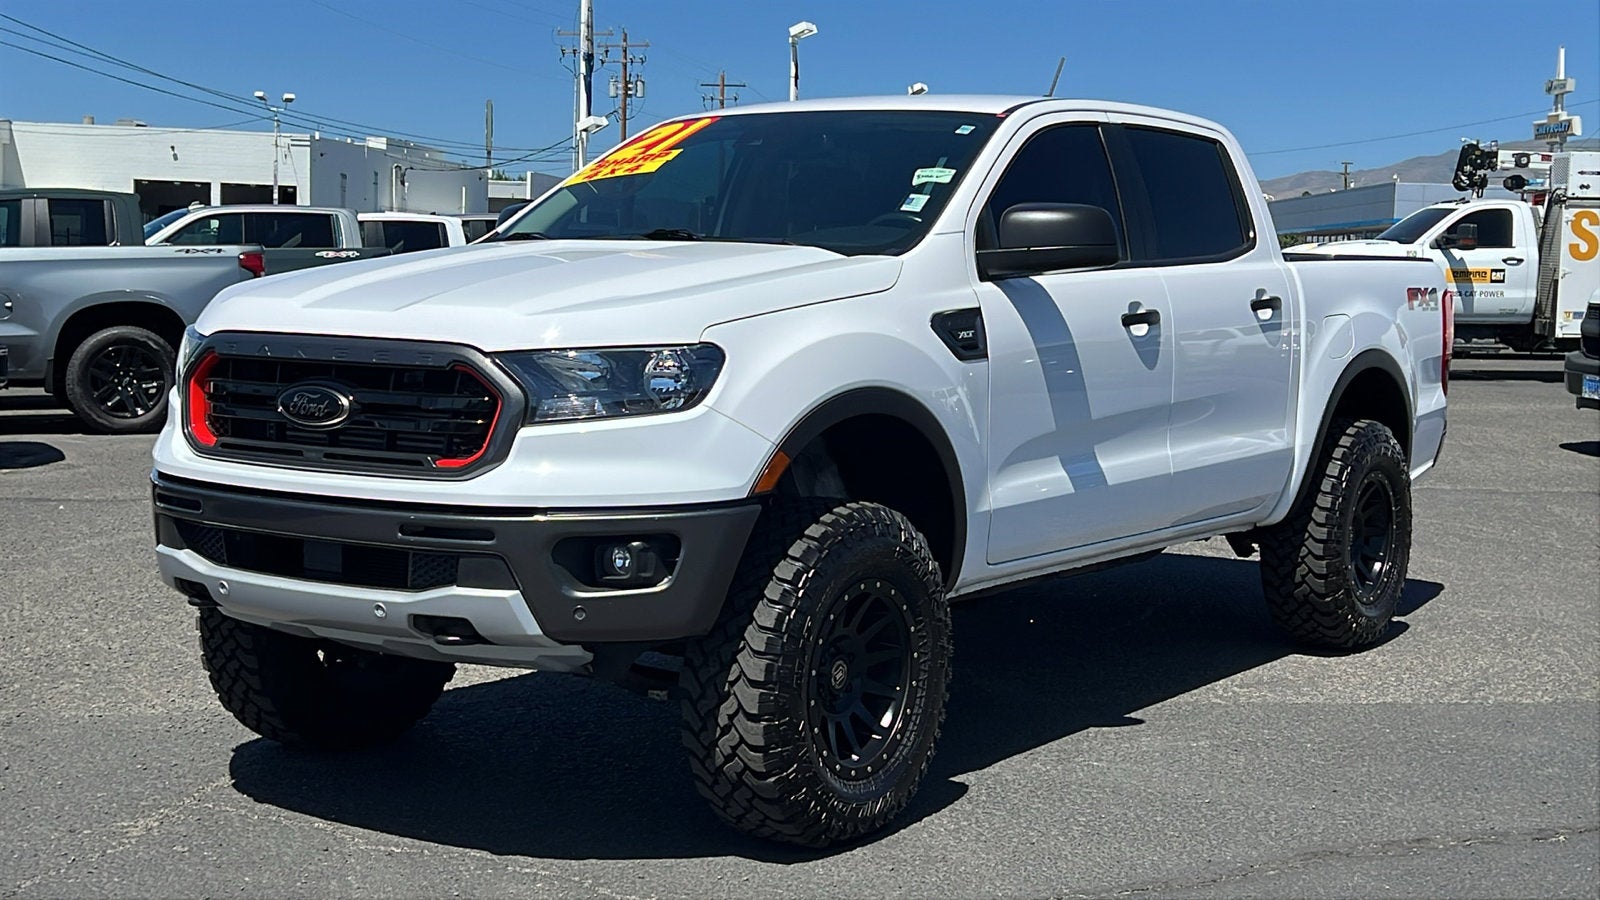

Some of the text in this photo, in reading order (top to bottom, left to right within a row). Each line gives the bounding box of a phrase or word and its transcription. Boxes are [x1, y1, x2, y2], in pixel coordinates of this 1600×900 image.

[600, 117, 715, 159] 21
[589, 149, 673, 172] SHARP
[1491, 271, 1505, 280] CAT
[1406, 287, 1439, 311] FX4
[1479, 290, 1505, 298] POWER
[957, 329, 975, 339] XLT
[289, 392, 333, 417] Ford
